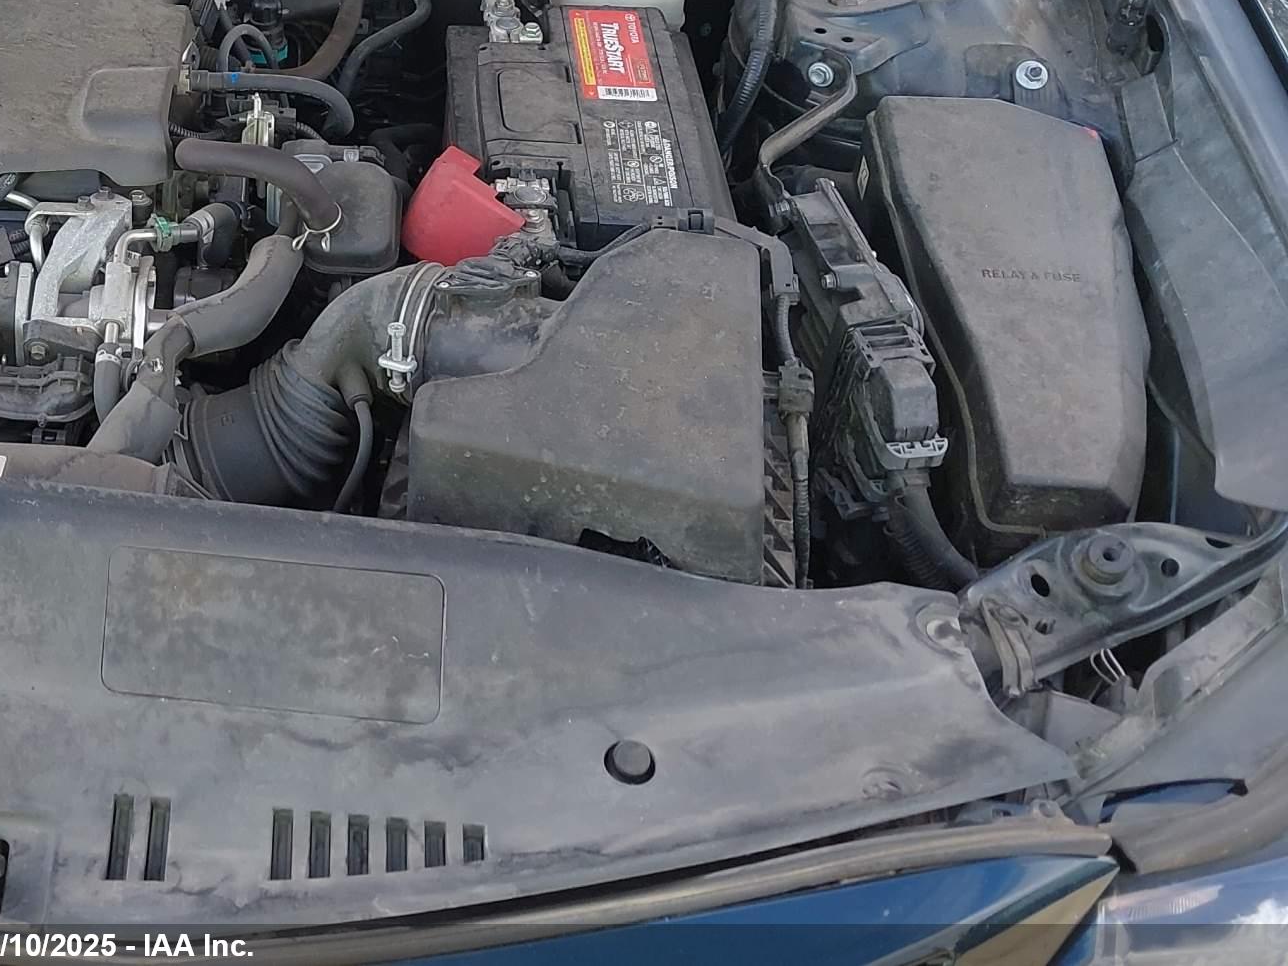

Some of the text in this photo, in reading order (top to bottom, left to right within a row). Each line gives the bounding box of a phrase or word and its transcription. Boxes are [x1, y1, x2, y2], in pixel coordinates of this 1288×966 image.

[627, 22, 640, 44] TOYOTA
[981, 268, 1025, 280] RELAY
[1044, 271, 1081, 283] FUSE
